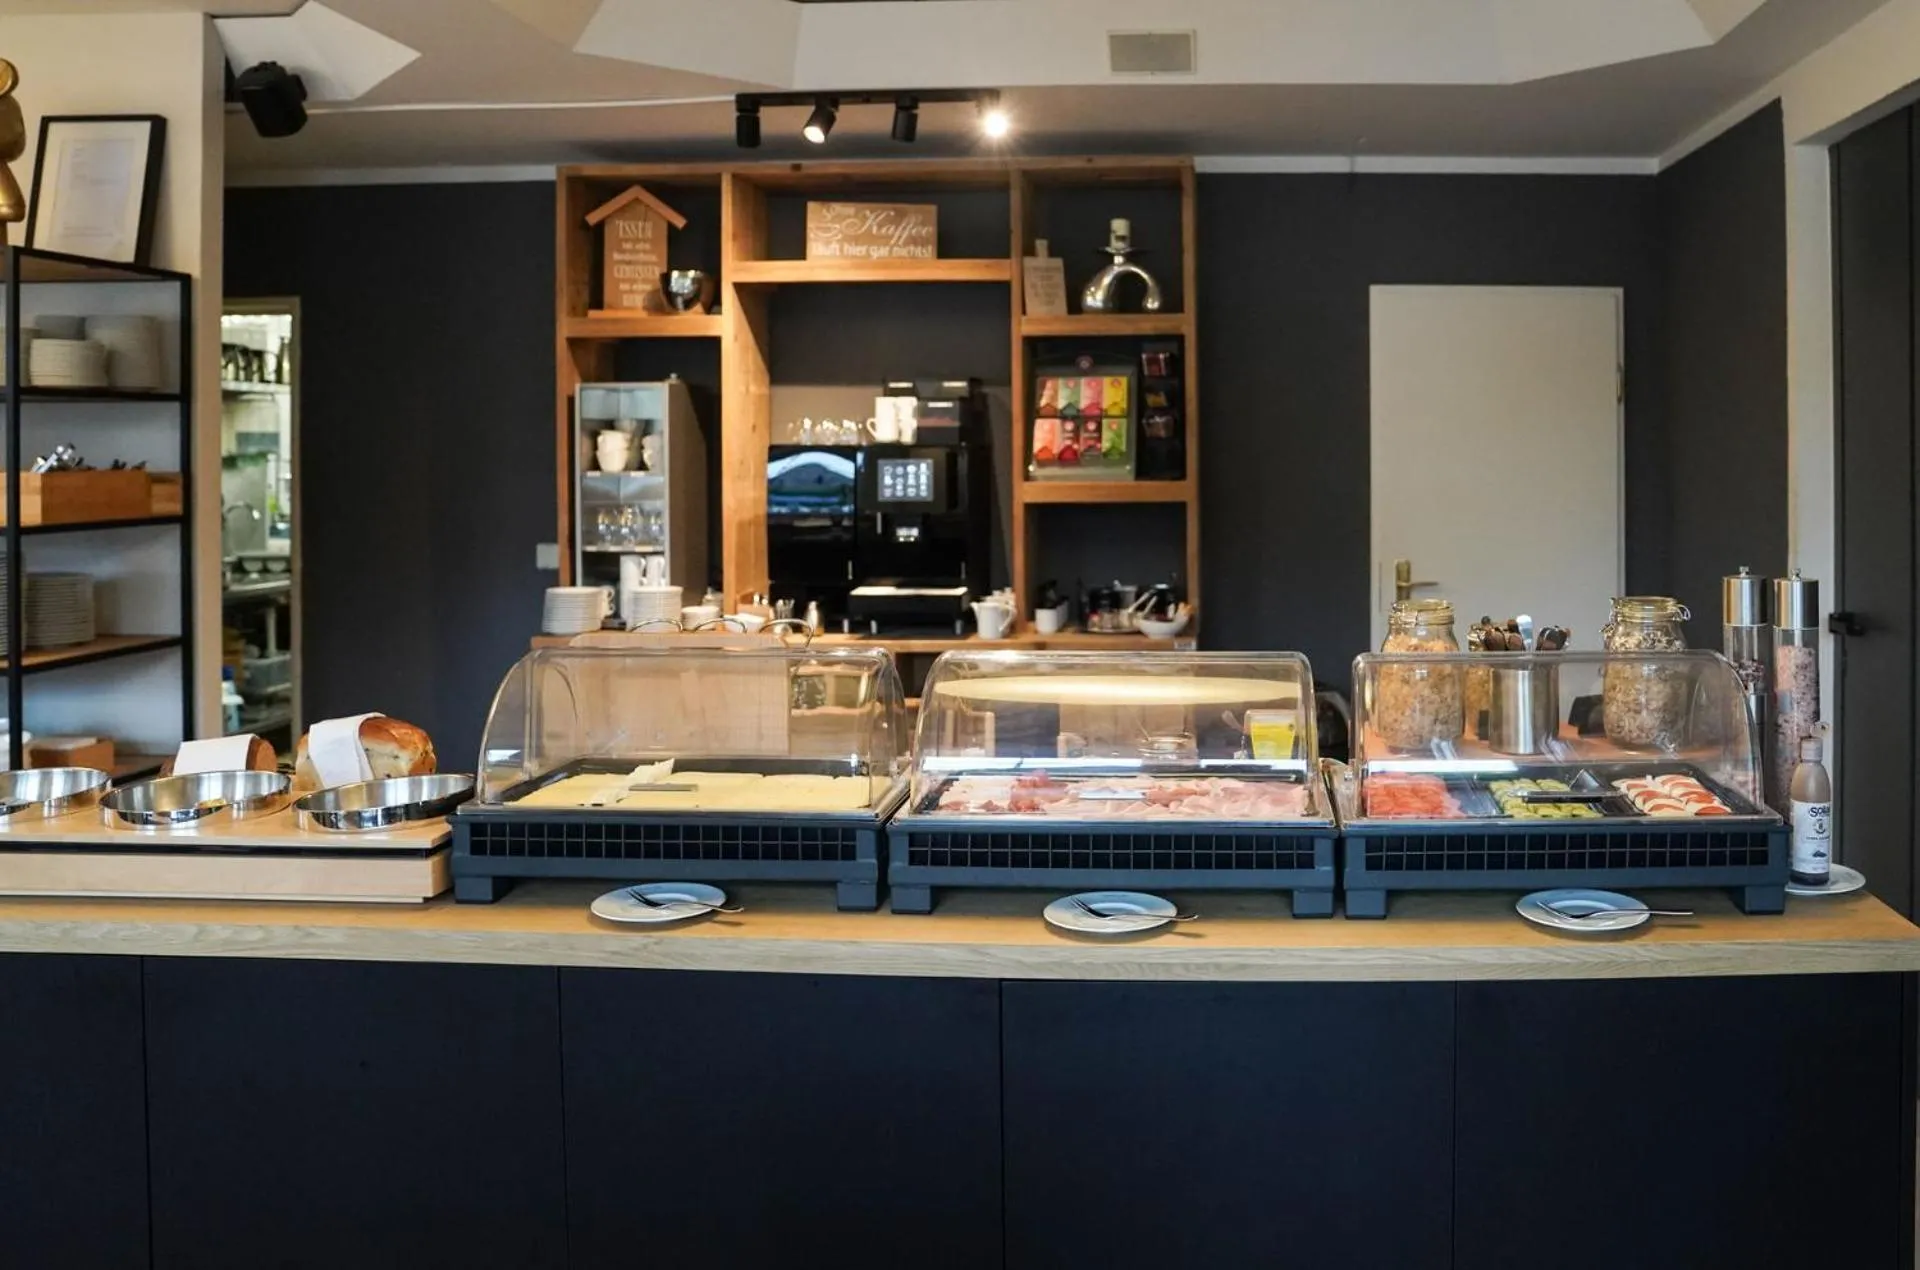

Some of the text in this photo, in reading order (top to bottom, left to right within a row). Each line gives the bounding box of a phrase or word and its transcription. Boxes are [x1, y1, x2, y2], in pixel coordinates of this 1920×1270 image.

[841, 208, 932, 246] Kaffee
[844, 242, 868, 256] hier
[870, 245, 890, 259] gar
